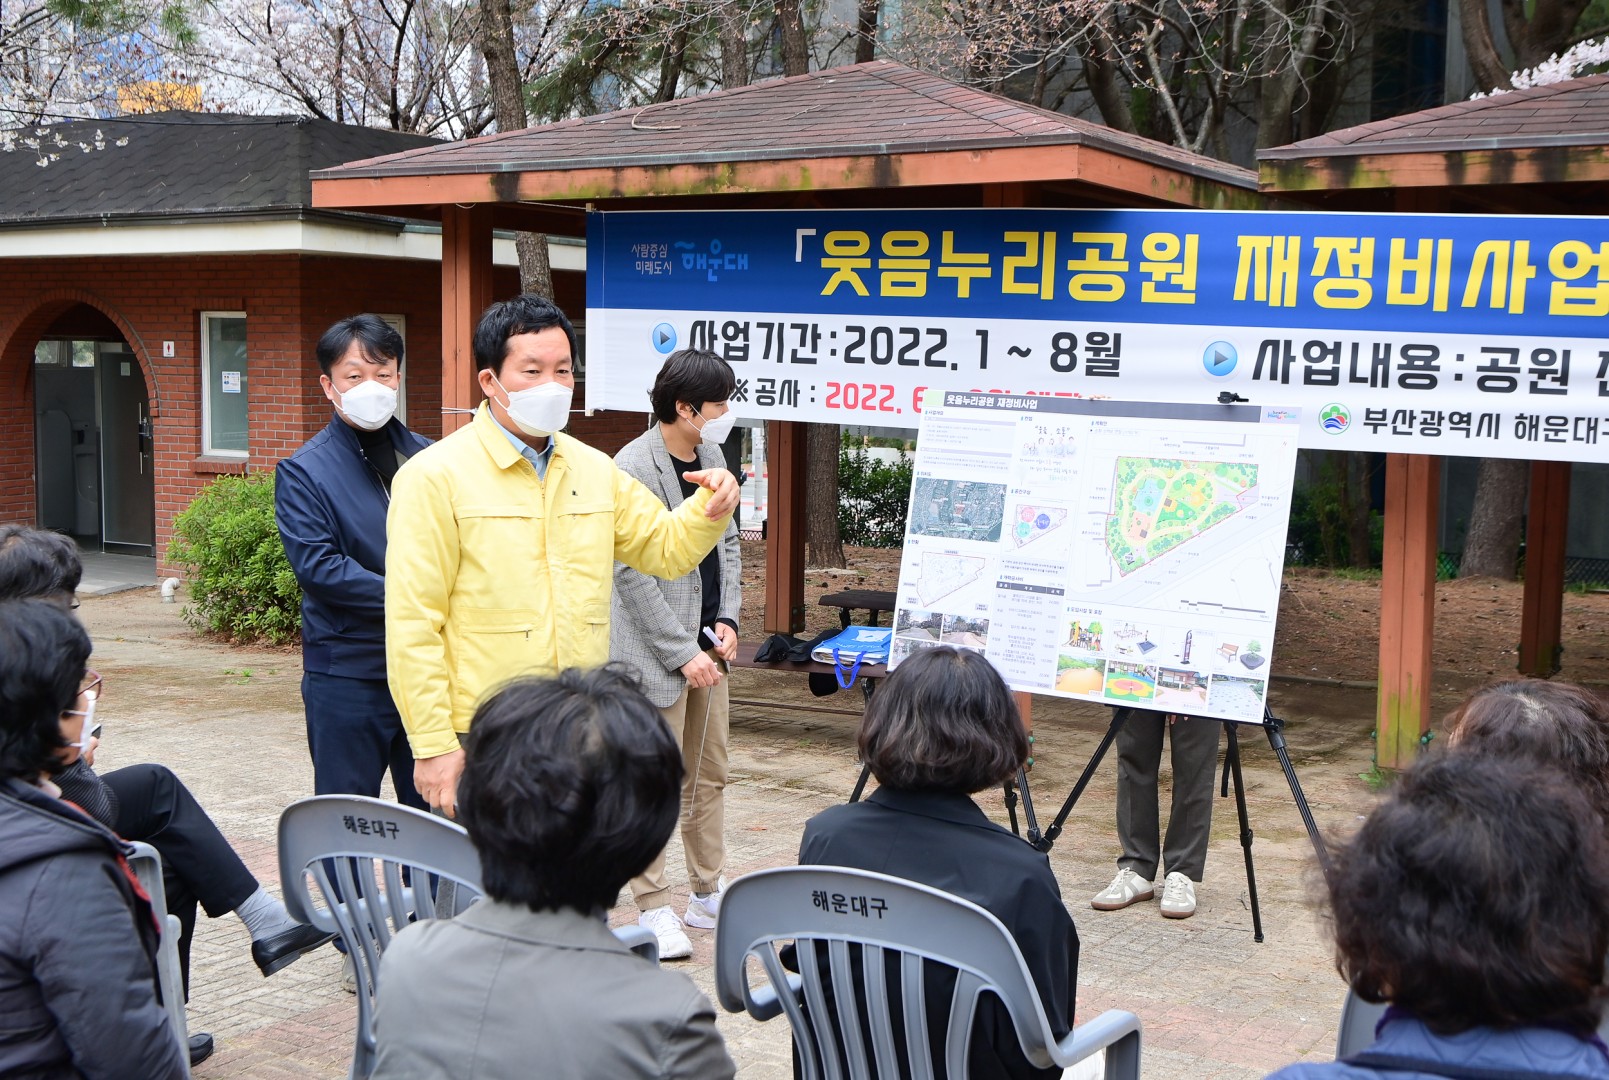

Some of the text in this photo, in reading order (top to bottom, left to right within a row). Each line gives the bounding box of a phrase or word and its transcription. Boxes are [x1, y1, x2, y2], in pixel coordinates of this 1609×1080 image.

[631, 243, 668, 258] 사람중심
[674, 238, 749, 282] 해운대
[635, 260, 672, 275] 미래도시
[1233, 235, 1609, 317] 재정비사업
[1049, 331, 1122, 377] 8월
[825, 381, 902, 414] 2022.
[946, 394, 1038, 410] 웃음누리공원 재정비사업
[1363, 407, 1501, 440] 부산광역시
[343, 815, 400, 840] 해운대구
[811, 890, 889, 919] 해운대구
